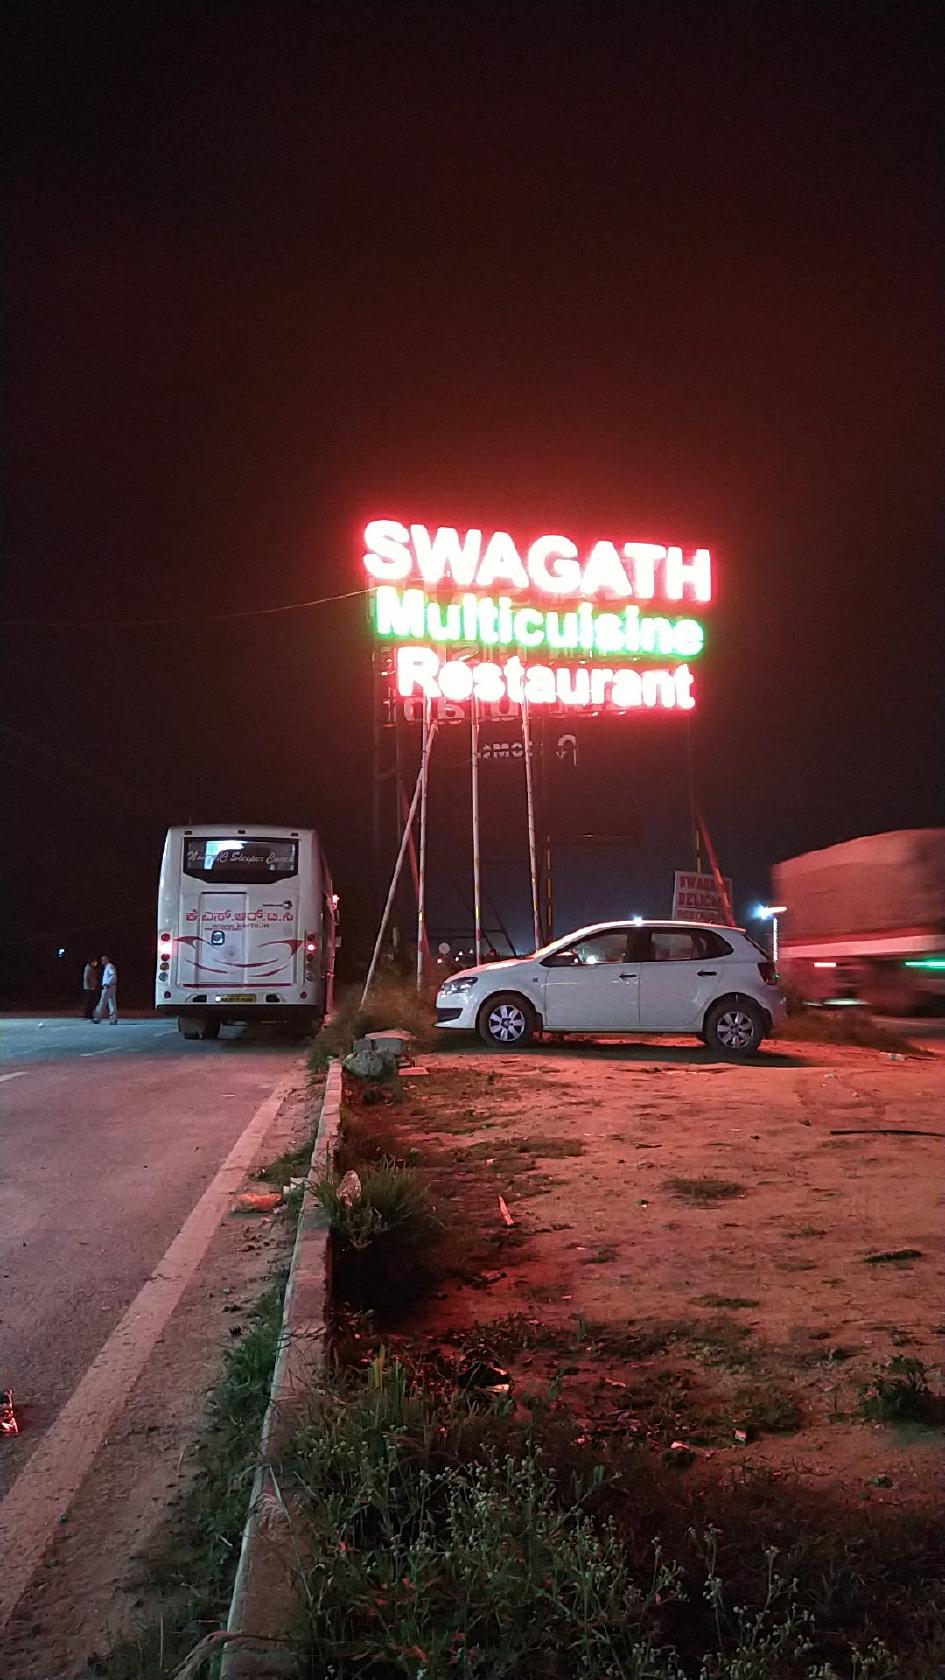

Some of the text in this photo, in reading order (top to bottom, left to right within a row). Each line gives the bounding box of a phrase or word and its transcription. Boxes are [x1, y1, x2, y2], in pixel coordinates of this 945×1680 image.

[363, 520, 711, 602] SWAGATH
[375, 586, 705, 656] Multicuisine
[397, 646, 696, 710] Restaurant
